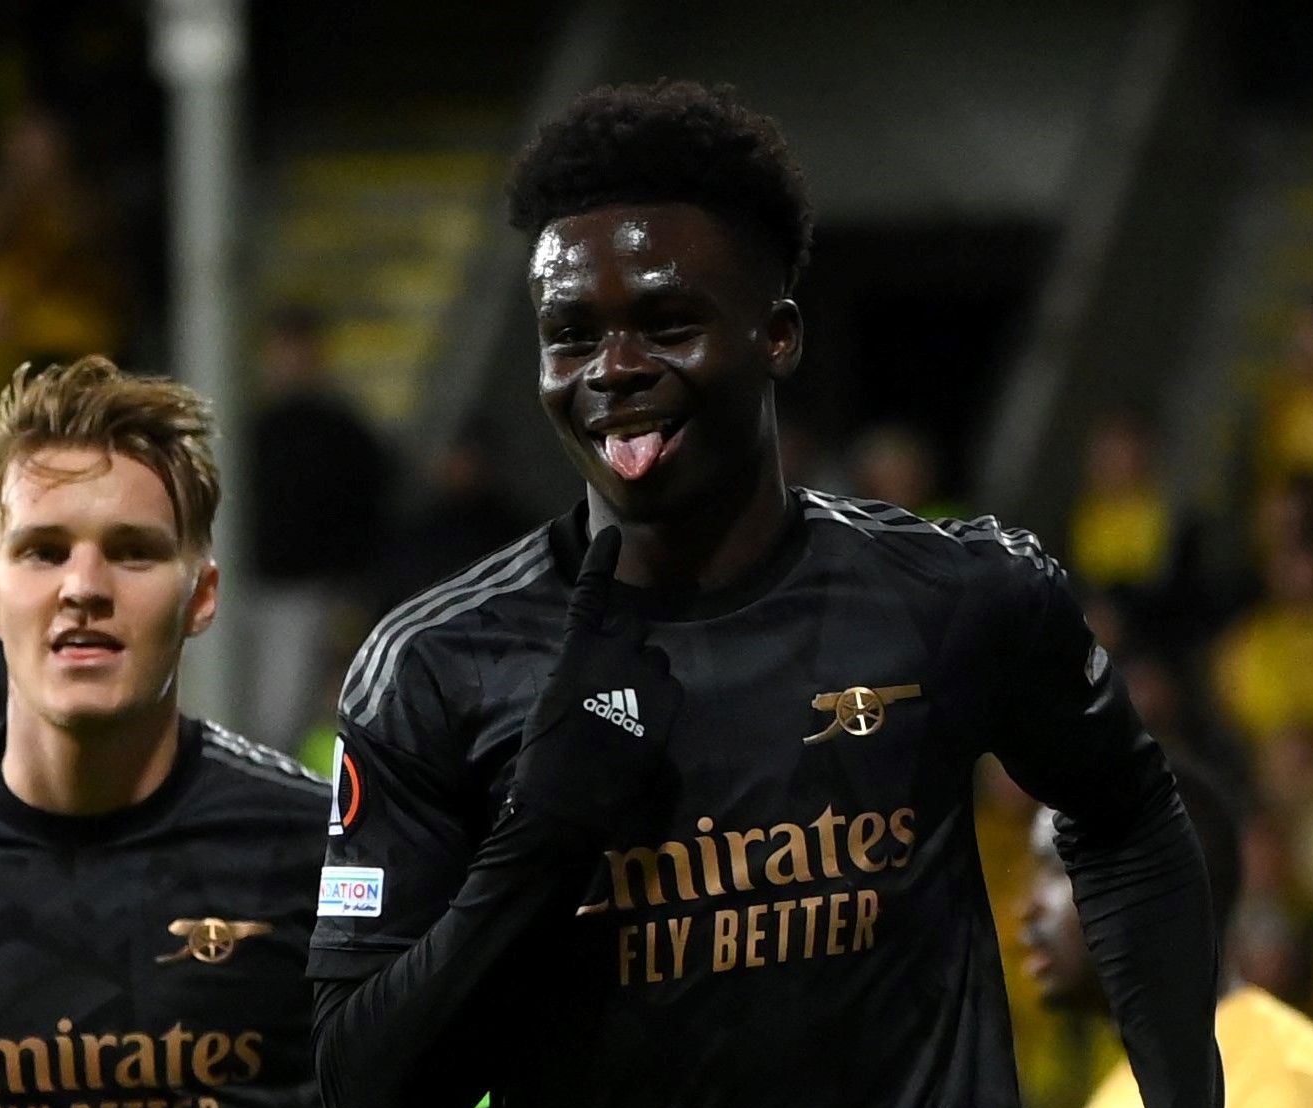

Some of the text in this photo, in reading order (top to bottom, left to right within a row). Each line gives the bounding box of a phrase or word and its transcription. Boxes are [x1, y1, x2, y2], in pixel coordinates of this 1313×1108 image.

[582, 698, 645, 738] adidas
[575, 803, 917, 917] mirates
[618, 889, 879, 986] FLY BETTER
